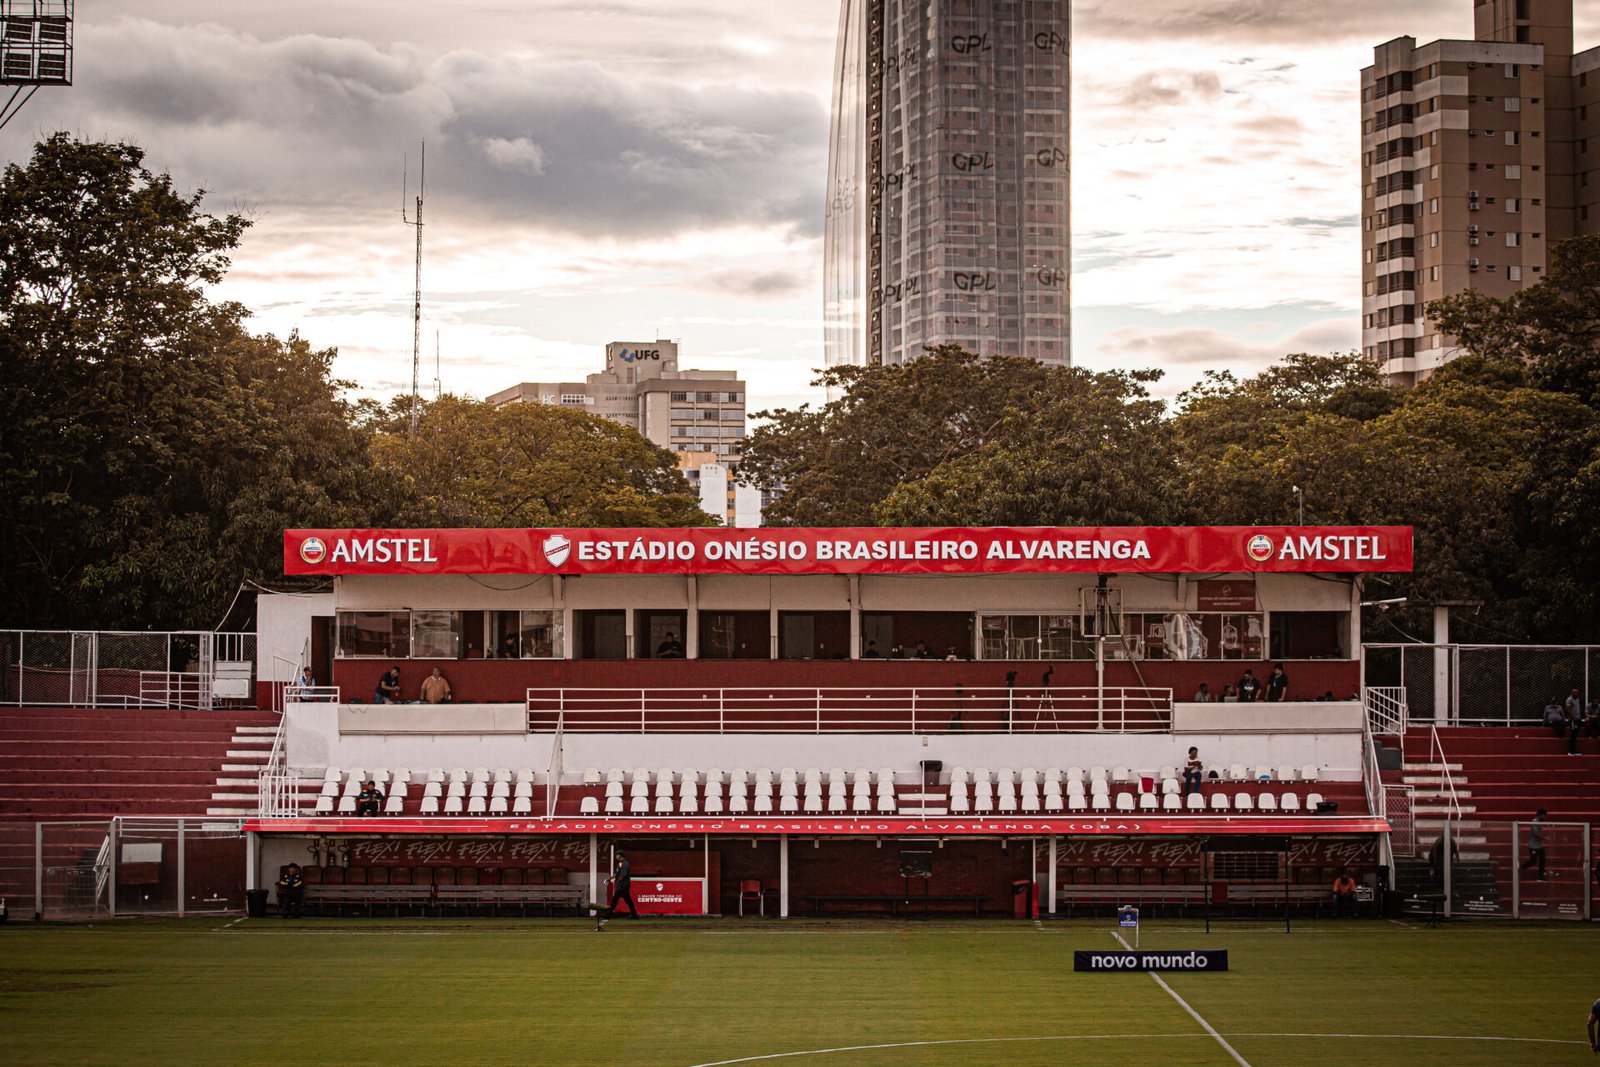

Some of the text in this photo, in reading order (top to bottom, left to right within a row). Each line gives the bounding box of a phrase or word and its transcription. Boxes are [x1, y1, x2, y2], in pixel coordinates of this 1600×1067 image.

[952, 32, 991, 54] GPL
[1034, 31, 1069, 57] GPL
[952, 152, 993, 172] GPL
[953, 271, 996, 292] GPL
[635, 349, 660, 361] UFG
[331, 538, 437, 564] AMSTEL
[578, 536, 695, 561] ESTÁDIO
[705, 536, 807, 561] ONÉSIO
[815, 541, 980, 561] BRASILEIRO
[987, 540, 1151, 560] ALVARENGA
[1278, 536, 1386, 561] AMSTEL
[353, 840, 401, 863] FLEXI
[405, 840, 453, 863] FLEXI
[457, 840, 505, 863] FLEXI
[509, 840, 558, 863] FLEXI
[1091, 841, 1145, 866] FLEXI
[1324, 840, 1376, 866] FLEXI
[1091, 951, 1208, 969] novo mundo
